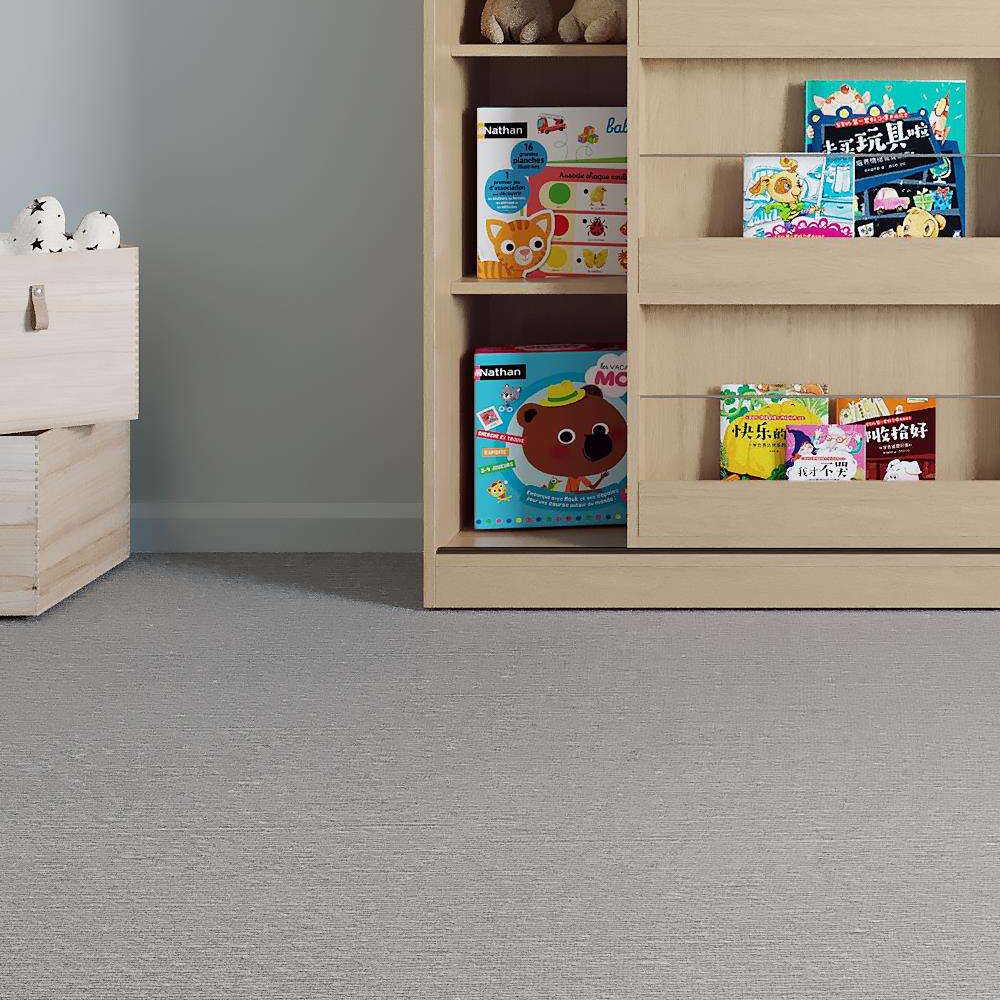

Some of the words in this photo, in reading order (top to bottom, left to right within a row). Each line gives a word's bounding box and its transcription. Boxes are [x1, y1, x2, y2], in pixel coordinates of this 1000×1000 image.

[484, 126, 523, 135] Nathan
[524, 142, 534, 151] 16
[480, 368, 521, 377] Nathan
[798, 461, 848, 478] 我才不哭
